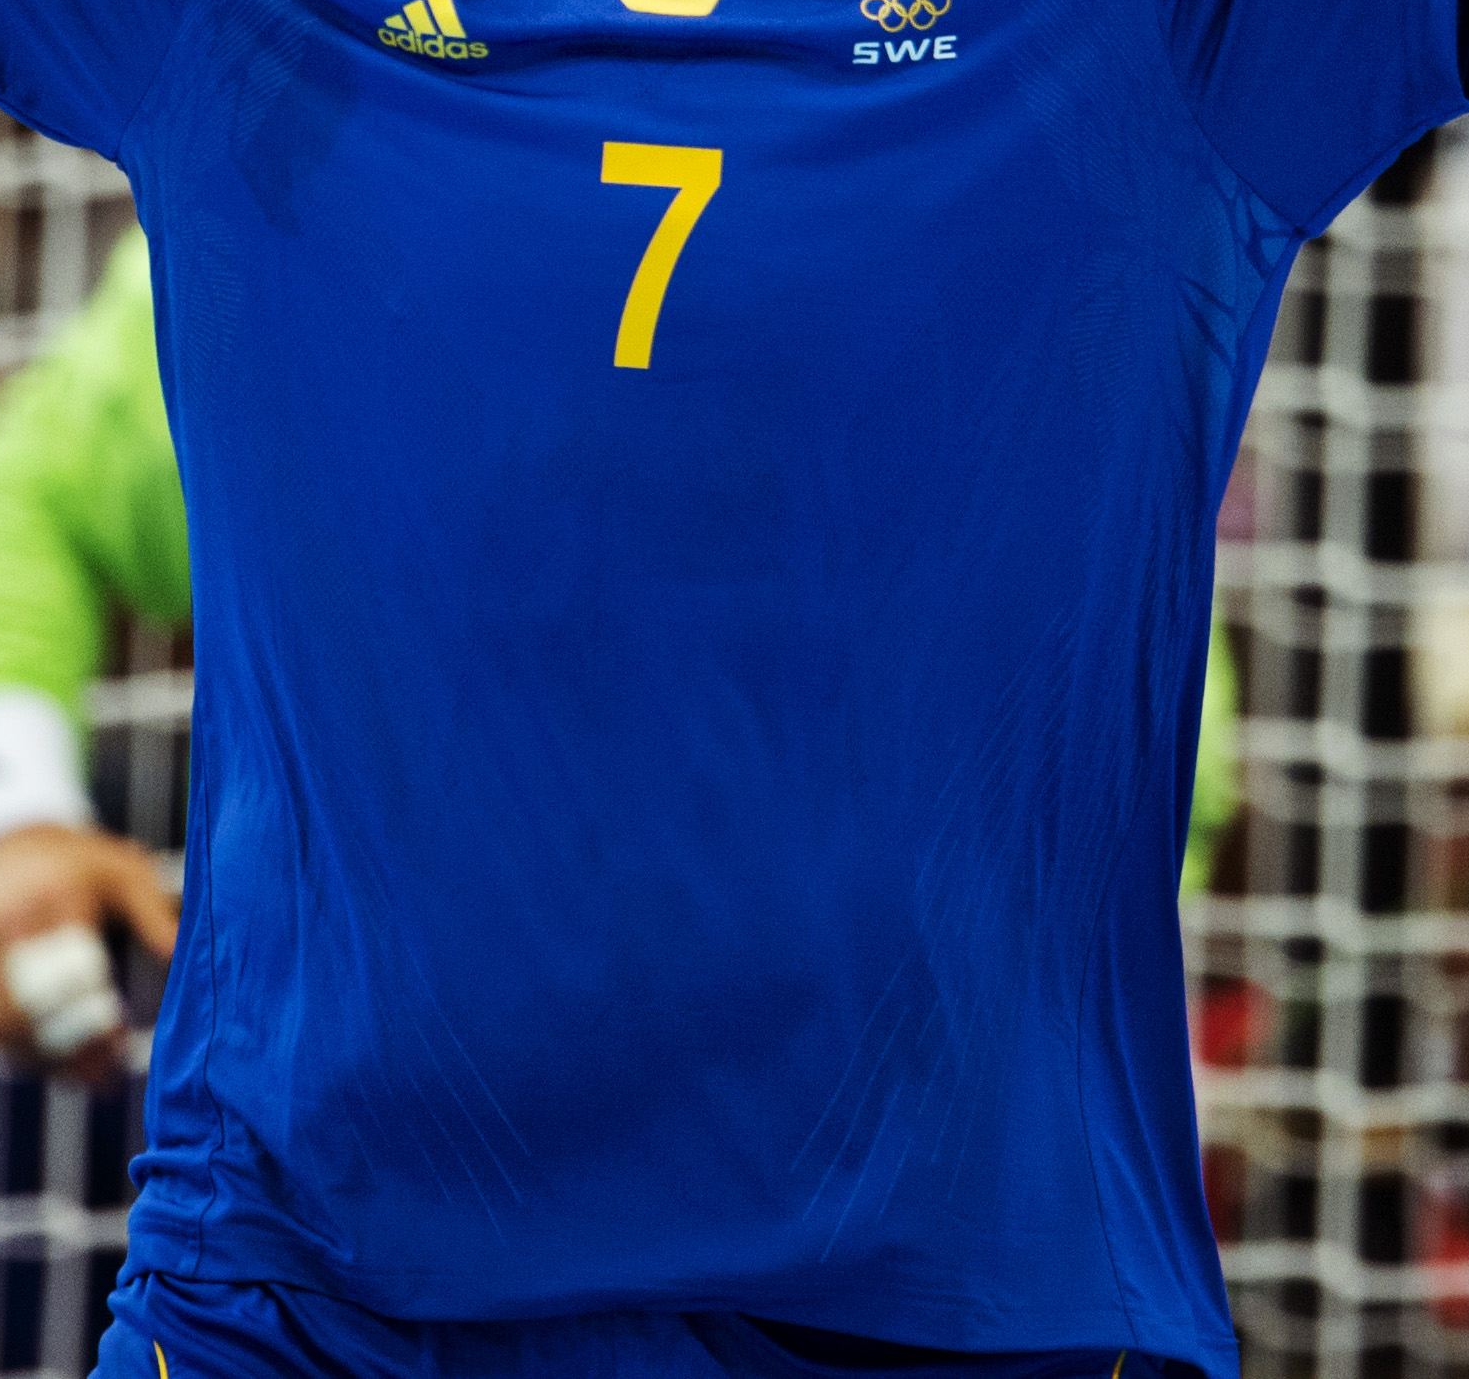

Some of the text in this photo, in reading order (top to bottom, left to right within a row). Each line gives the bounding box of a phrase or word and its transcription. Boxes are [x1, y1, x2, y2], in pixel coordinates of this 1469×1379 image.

[377, 28, 489, 59] adidas
[852, 35, 957, 64] SWE
[600, 140, 723, 370] 7
